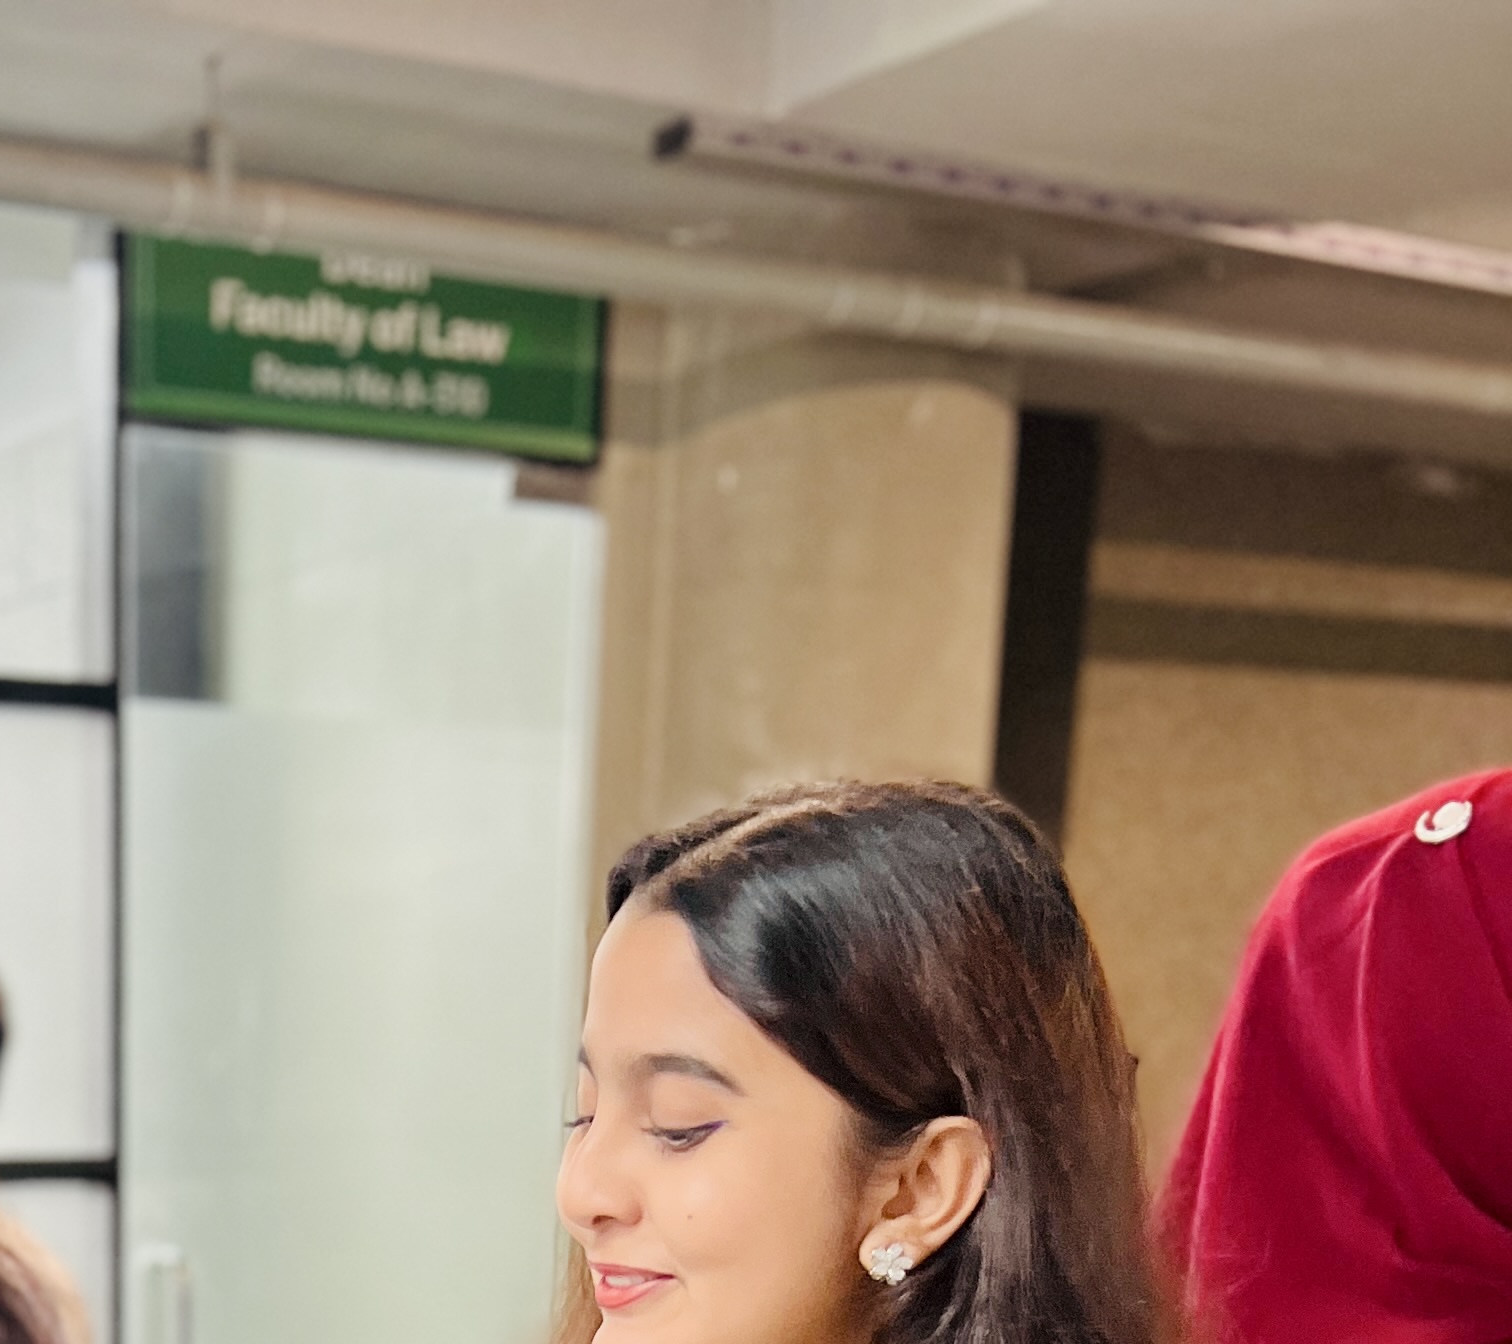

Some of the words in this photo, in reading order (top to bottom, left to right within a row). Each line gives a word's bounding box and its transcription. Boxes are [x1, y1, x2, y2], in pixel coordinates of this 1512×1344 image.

[209, 278, 365, 357] Faculty
[369, 301, 417, 353] of
[418, 304, 510, 364] Law
